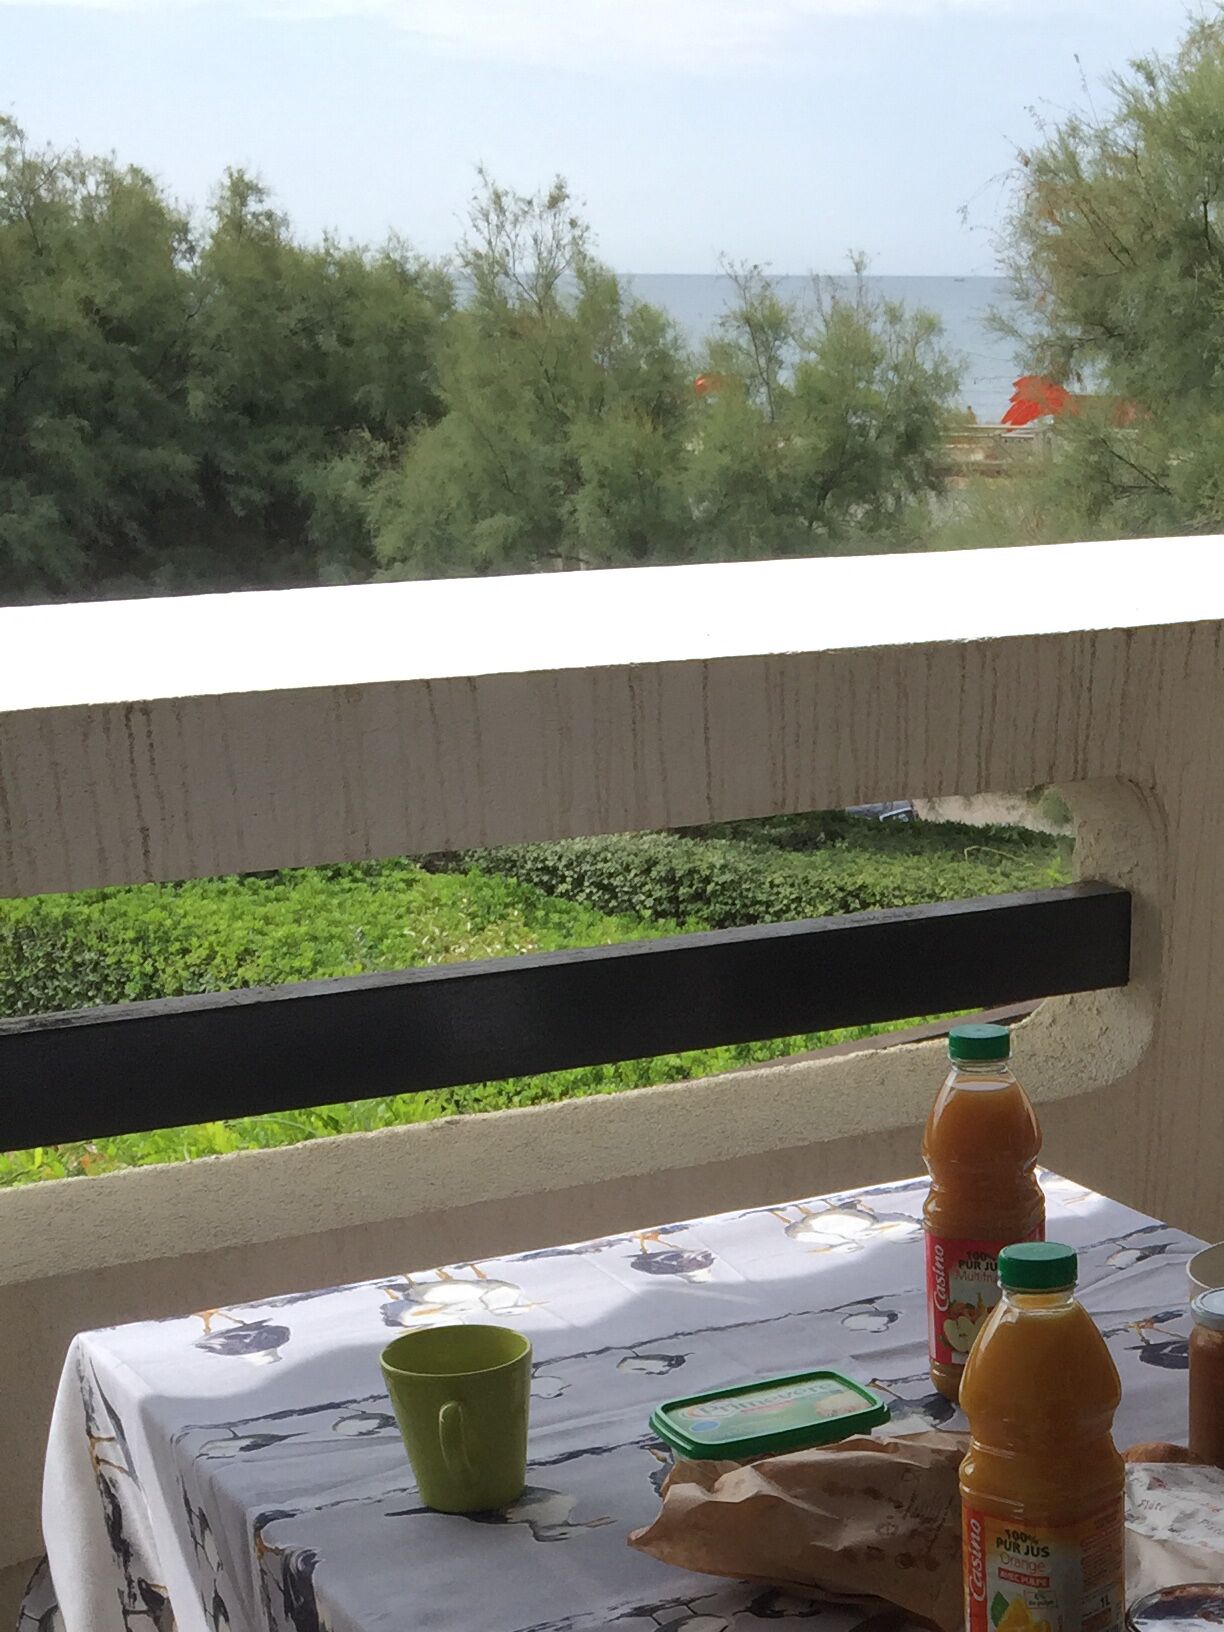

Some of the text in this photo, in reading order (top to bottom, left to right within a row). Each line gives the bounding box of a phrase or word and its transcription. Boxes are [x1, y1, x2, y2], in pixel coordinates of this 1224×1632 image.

[958, 1259, 998, 1272] PUR JU
[932, 1244, 949, 1312] Casino
[996, 1537, 1050, 1558] PUR JUS
[1005, 1529, 1039, 1546] 100%
[969, 1518, 986, 1602] Casino
[999, 1552, 1047, 1574] Orange
